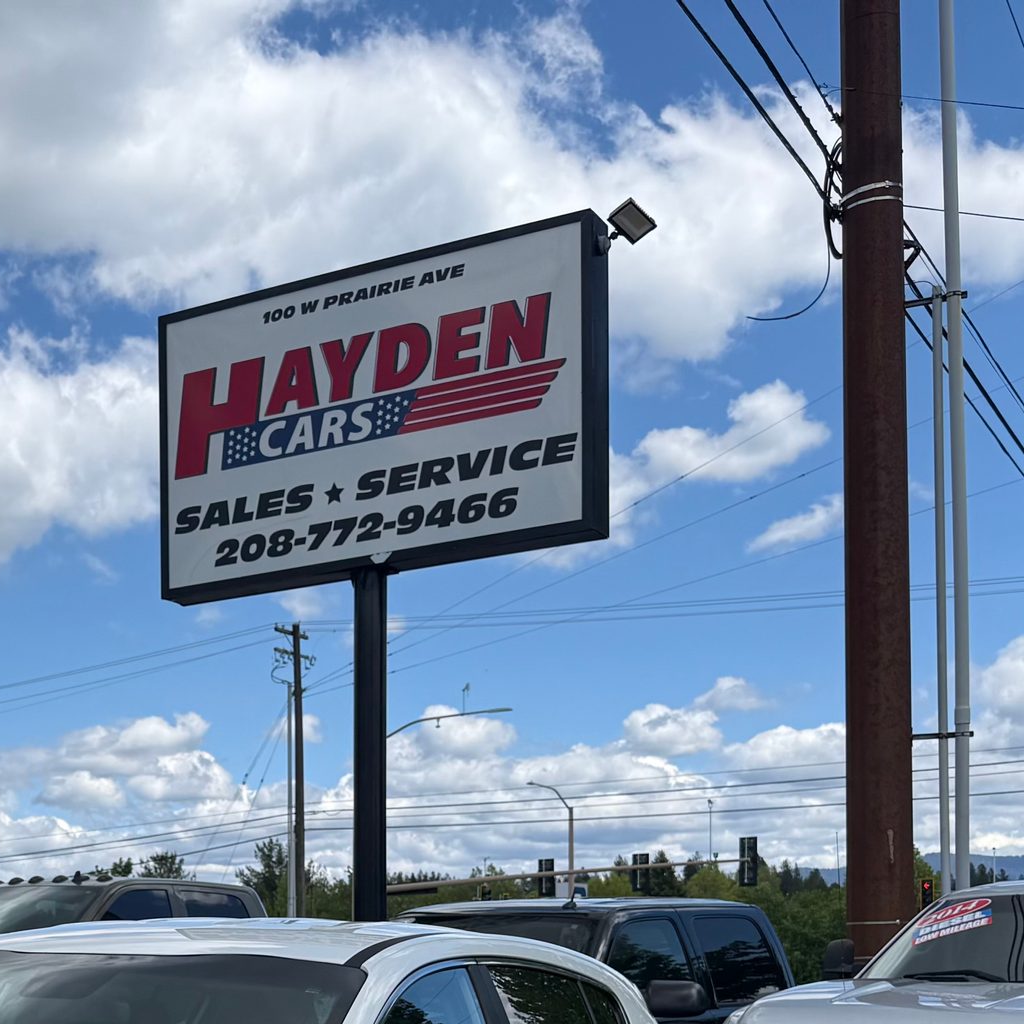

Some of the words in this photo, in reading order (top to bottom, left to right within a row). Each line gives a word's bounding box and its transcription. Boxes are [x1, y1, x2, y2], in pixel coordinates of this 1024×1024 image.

[262, 308, 296, 324] 100
[300, 300, 319, 315] W
[322, 276, 415, 310] PRAIRIE
[418, 264, 465, 287] AVE
[175, 292, 552, 480] HAYDEN
[258, 403, 375, 457] CARS
[176, 484, 315, 534] SALES
[355, 433, 578, 501] SERVICE
[214, 487, 519, 567] 208-772-9466
[915, 931, 940, 944] LOW
[940, 918, 989, 937] MILEAGE
[919, 912, 986, 936] DIESEL
